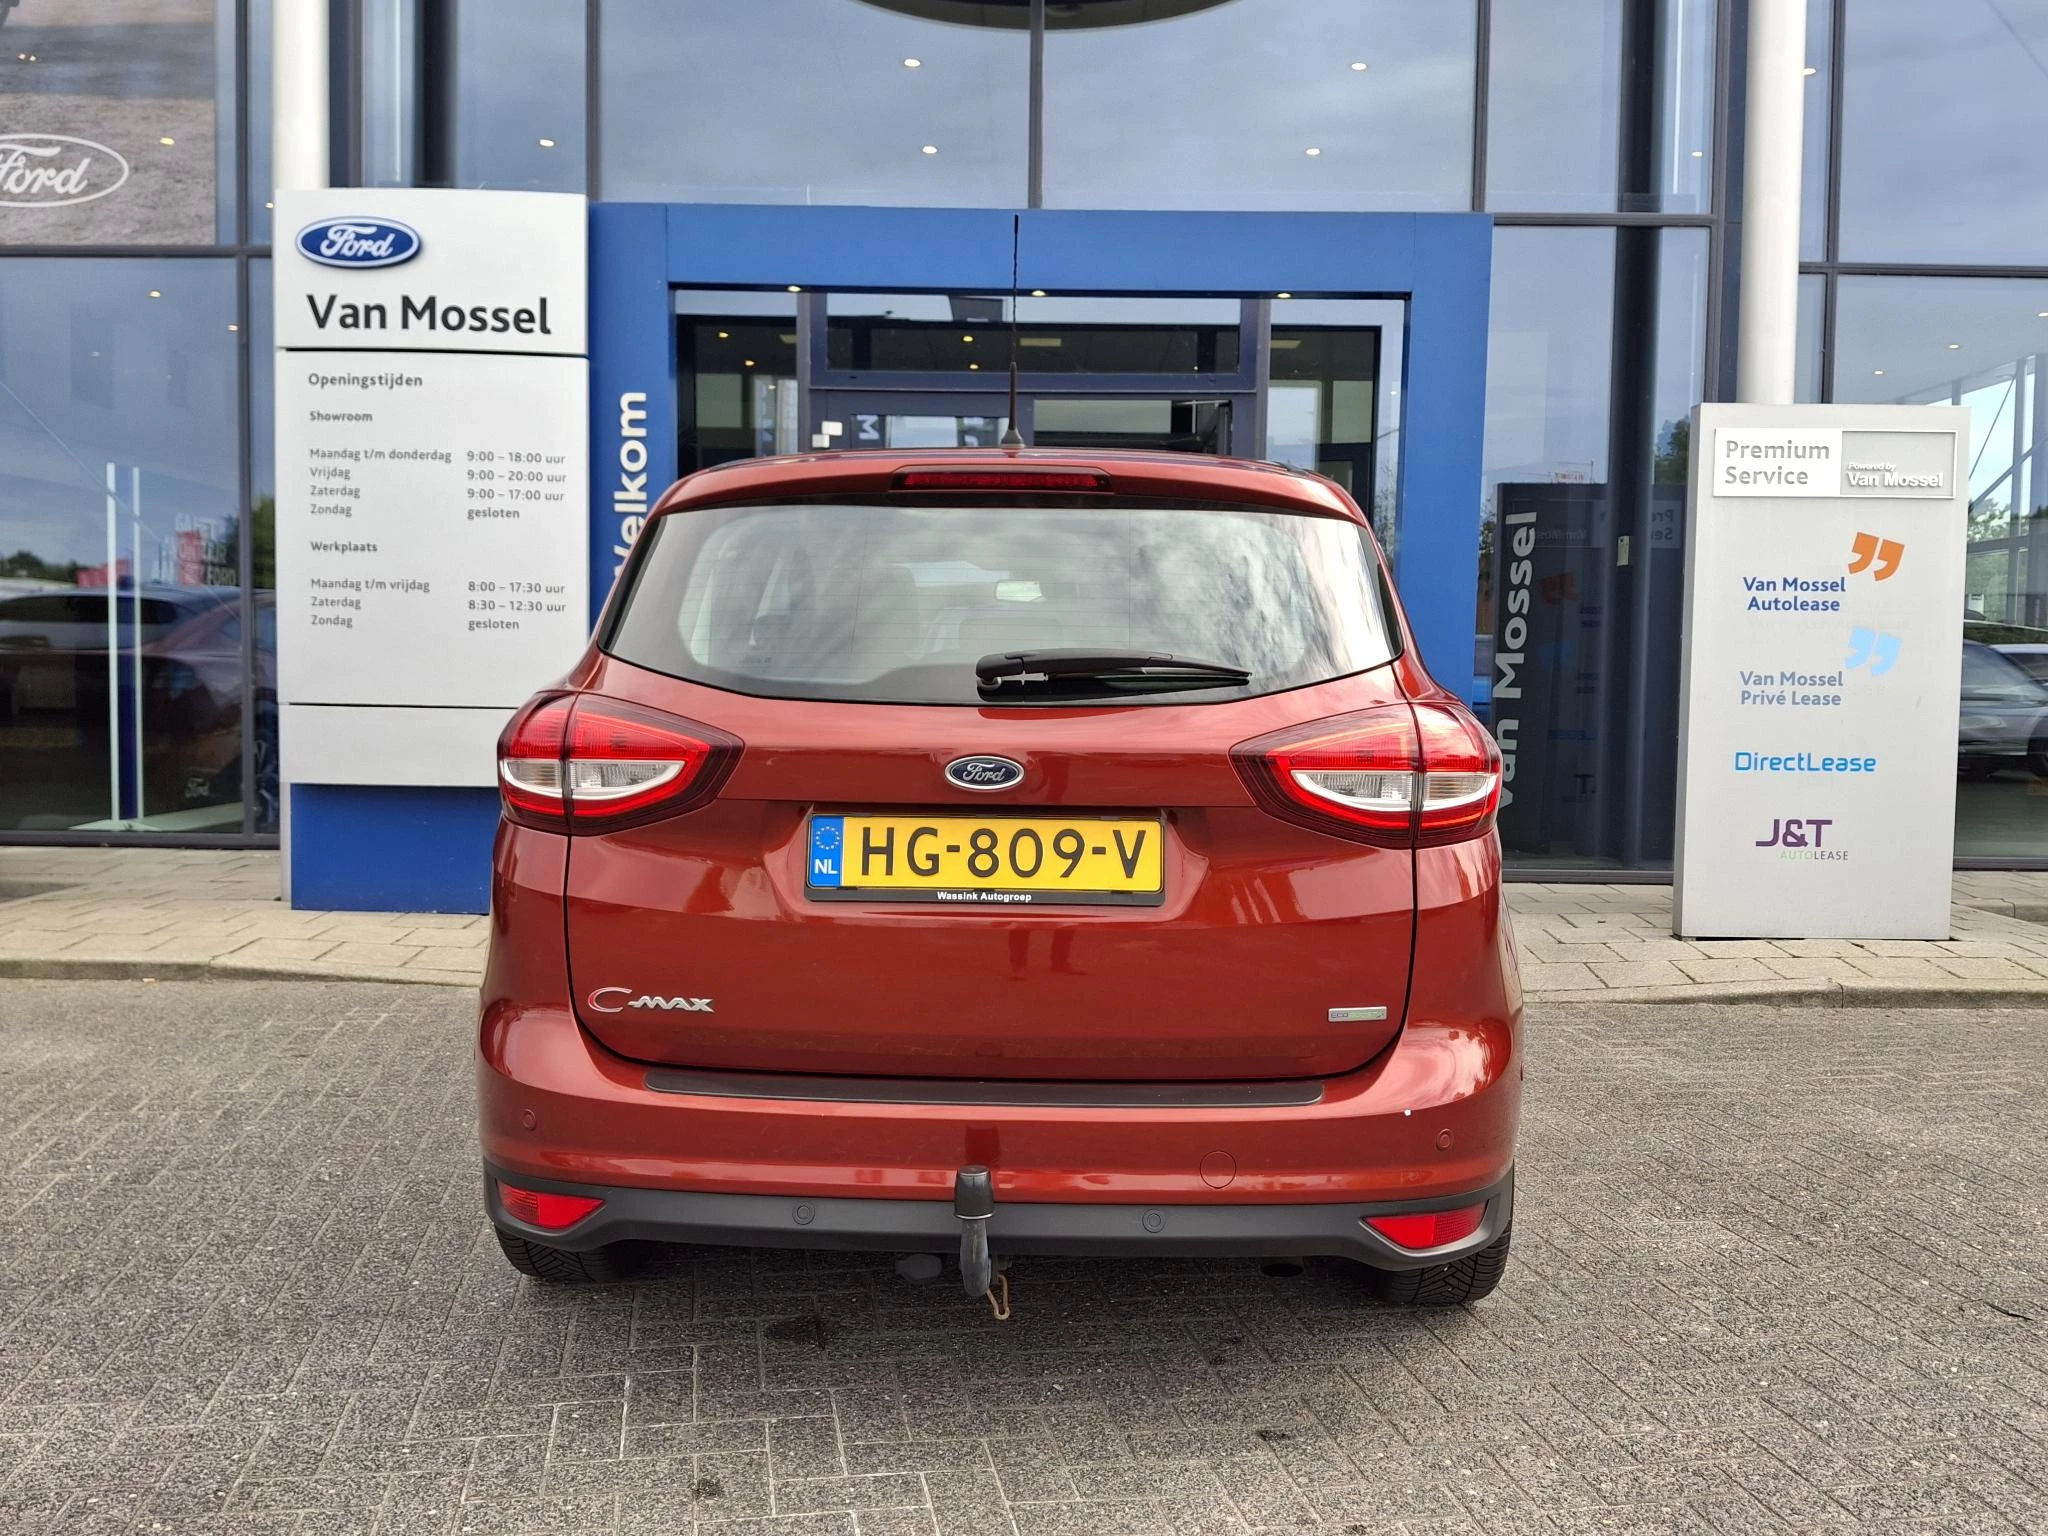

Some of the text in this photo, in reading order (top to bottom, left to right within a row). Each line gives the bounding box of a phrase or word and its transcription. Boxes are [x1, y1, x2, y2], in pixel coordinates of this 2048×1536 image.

[320, 224, 395, 257] Ford
[307, 294, 552, 334] Van Mossel
[308, 373, 423, 388] Openingstijden
[309, 410, 373, 422] Showroom
[310, 448, 360, 461] Maandag
[364, 449, 386, 460] t/m
[388, 449, 452, 463] donderdag
[467, 451, 495, 462] 9:00
[508, 452, 542, 463] 18:00
[545, 456, 566, 464] uur
[1726, 440, 1830, 460] Premium
[310, 467, 351, 480] Vrijdag
[467, 469, 495, 480] 9:00
[508, 471, 543, 482] 20:00
[547, 474, 567, 482] uur
[1725, 466, 1809, 485] Service
[1848, 472, 1944, 487] Van Mossel
[614, 392, 647, 577] elkom
[310, 485, 360, 499] Zaterdag
[467, 488, 495, 499] 9:00
[508, 489, 541, 500] 17:00
[545, 493, 565, 501] uur
[310, 504, 520, 519] Zondag gesloten
[311, 541, 378, 554] Werkplaats
[311, 578, 361, 591] Maandag
[365, 579, 386, 590] t/m
[390, 580, 430, 593] vrijdag
[468, 581, 496, 592] 8:00
[509, 582, 542, 593] 17:30
[545, 585, 566, 593] uur
[1743, 577, 1846, 592] Van Mossel
[311, 596, 361, 610] Zaterdag
[468, 600, 496, 610] 8:30
[509, 601, 543, 612] 12:30
[546, 604, 567, 612] uur
[1493, 512, 1537, 699] Mossel
[1747, 596, 1840, 611] Autolease
[311, 615, 520, 631] Zondag gesloten
[1740, 671, 1844, 686] Van Mossel
[1740, 690, 1841, 706] Privé Lease
[1735, 752, 1877, 772] DirectLease
[963, 763, 1004, 782] Ford
[1755, 818, 1833, 848] J&T
[861, 826, 1146, 878] HG-809-V
[1780, 850, 1849, 861] AUTOLEASE
[814, 859, 838, 875] NL
[937, 891, 1032, 903] Wassink Autogroep
